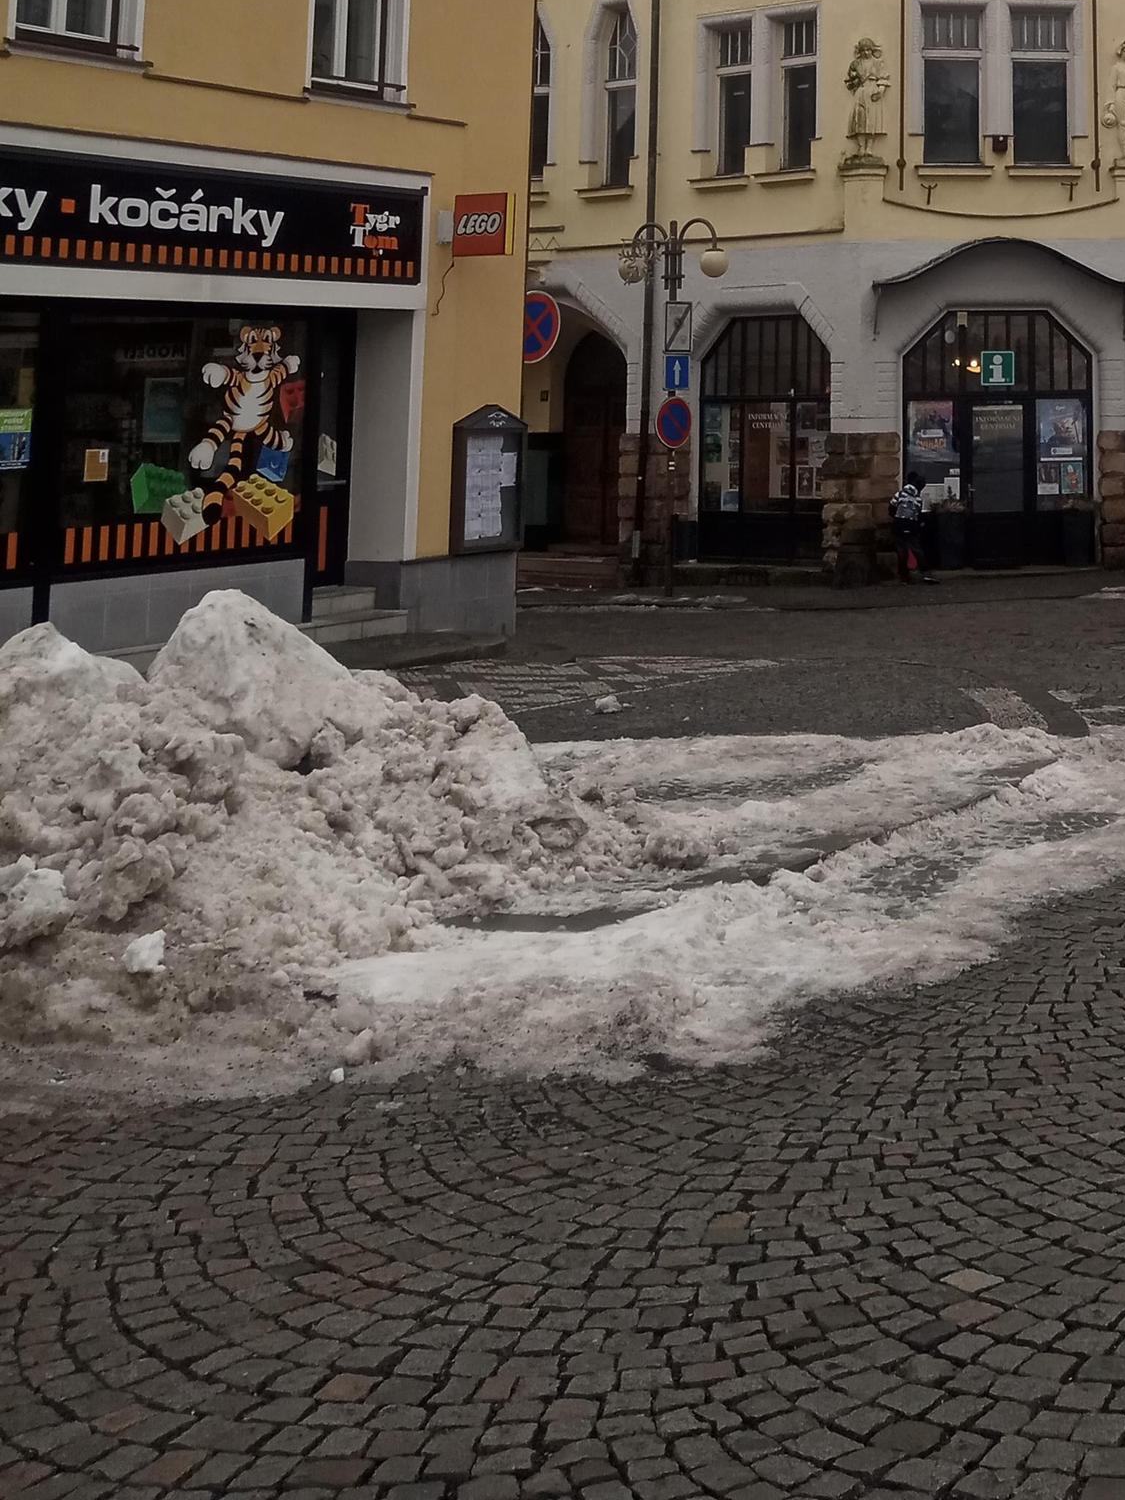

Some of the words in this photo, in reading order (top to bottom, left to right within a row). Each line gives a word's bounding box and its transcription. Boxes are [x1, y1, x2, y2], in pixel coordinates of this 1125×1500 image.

[88, 183, 285, 248] kočárky
[349, 202, 401, 233] Tygr
[456, 212, 503, 236] LEGO
[349, 224, 400, 250] Tom
